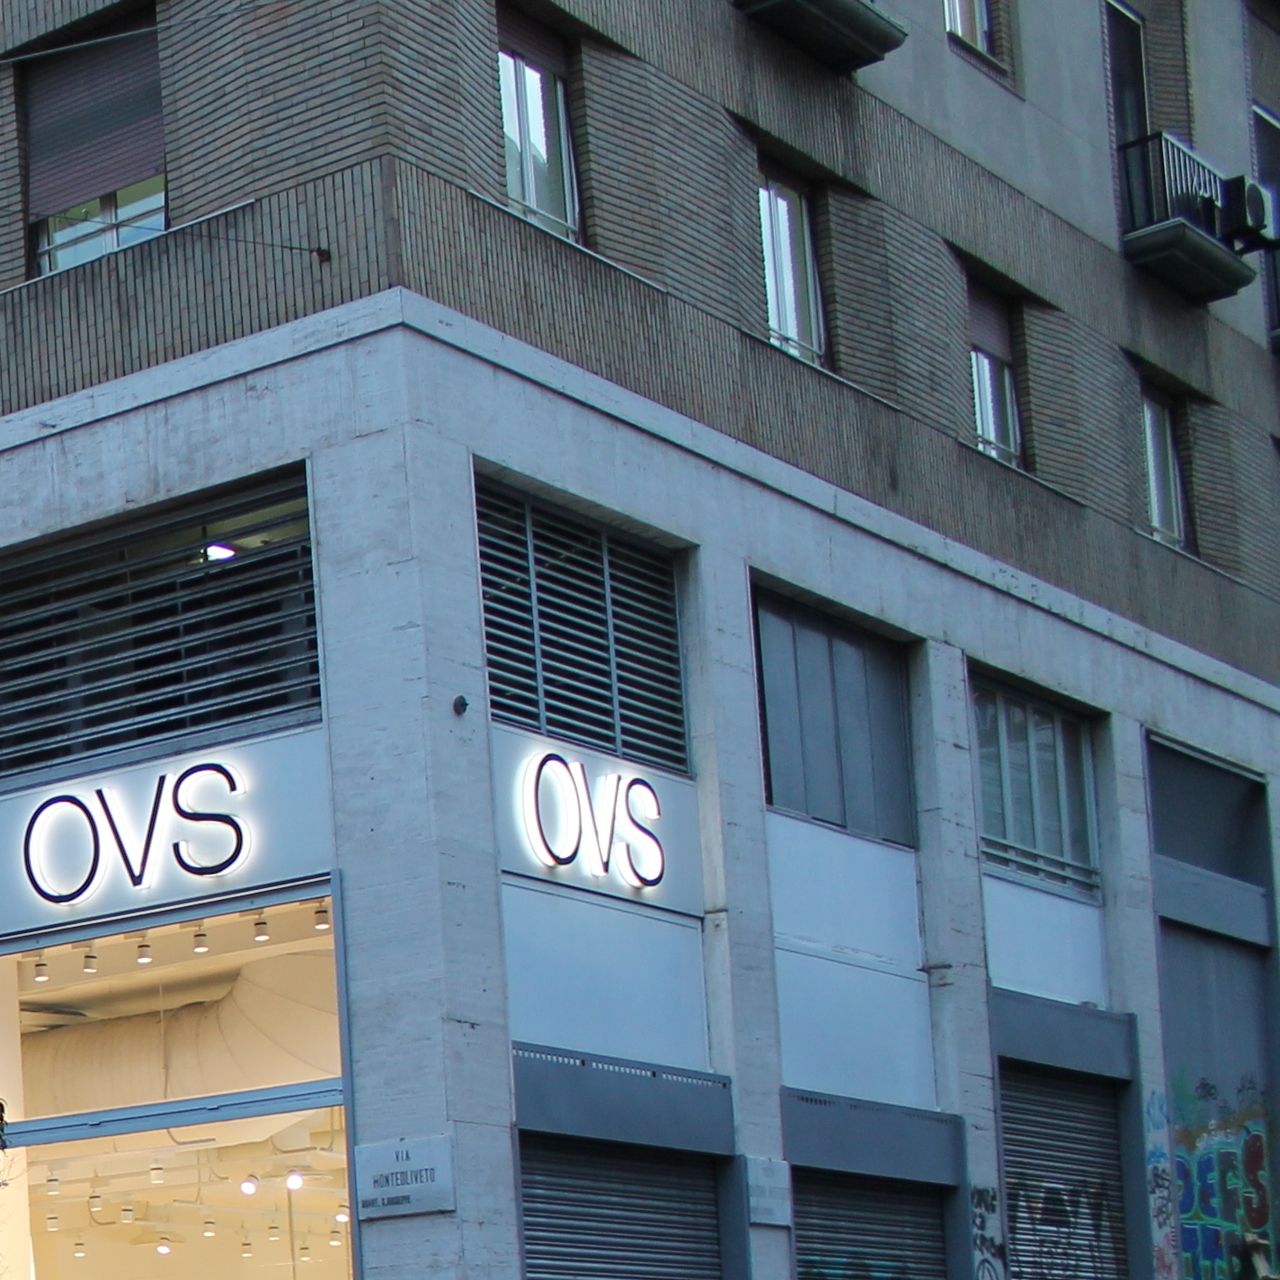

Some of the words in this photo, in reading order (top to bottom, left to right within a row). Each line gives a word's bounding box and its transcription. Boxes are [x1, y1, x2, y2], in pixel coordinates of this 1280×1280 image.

[24, 762, 251, 904] OVS
[525, 753, 665, 888] OVS
[372, 1168, 436, 1189] MONTEOLIVETO
[394, 1150, 411, 1162] VIA
